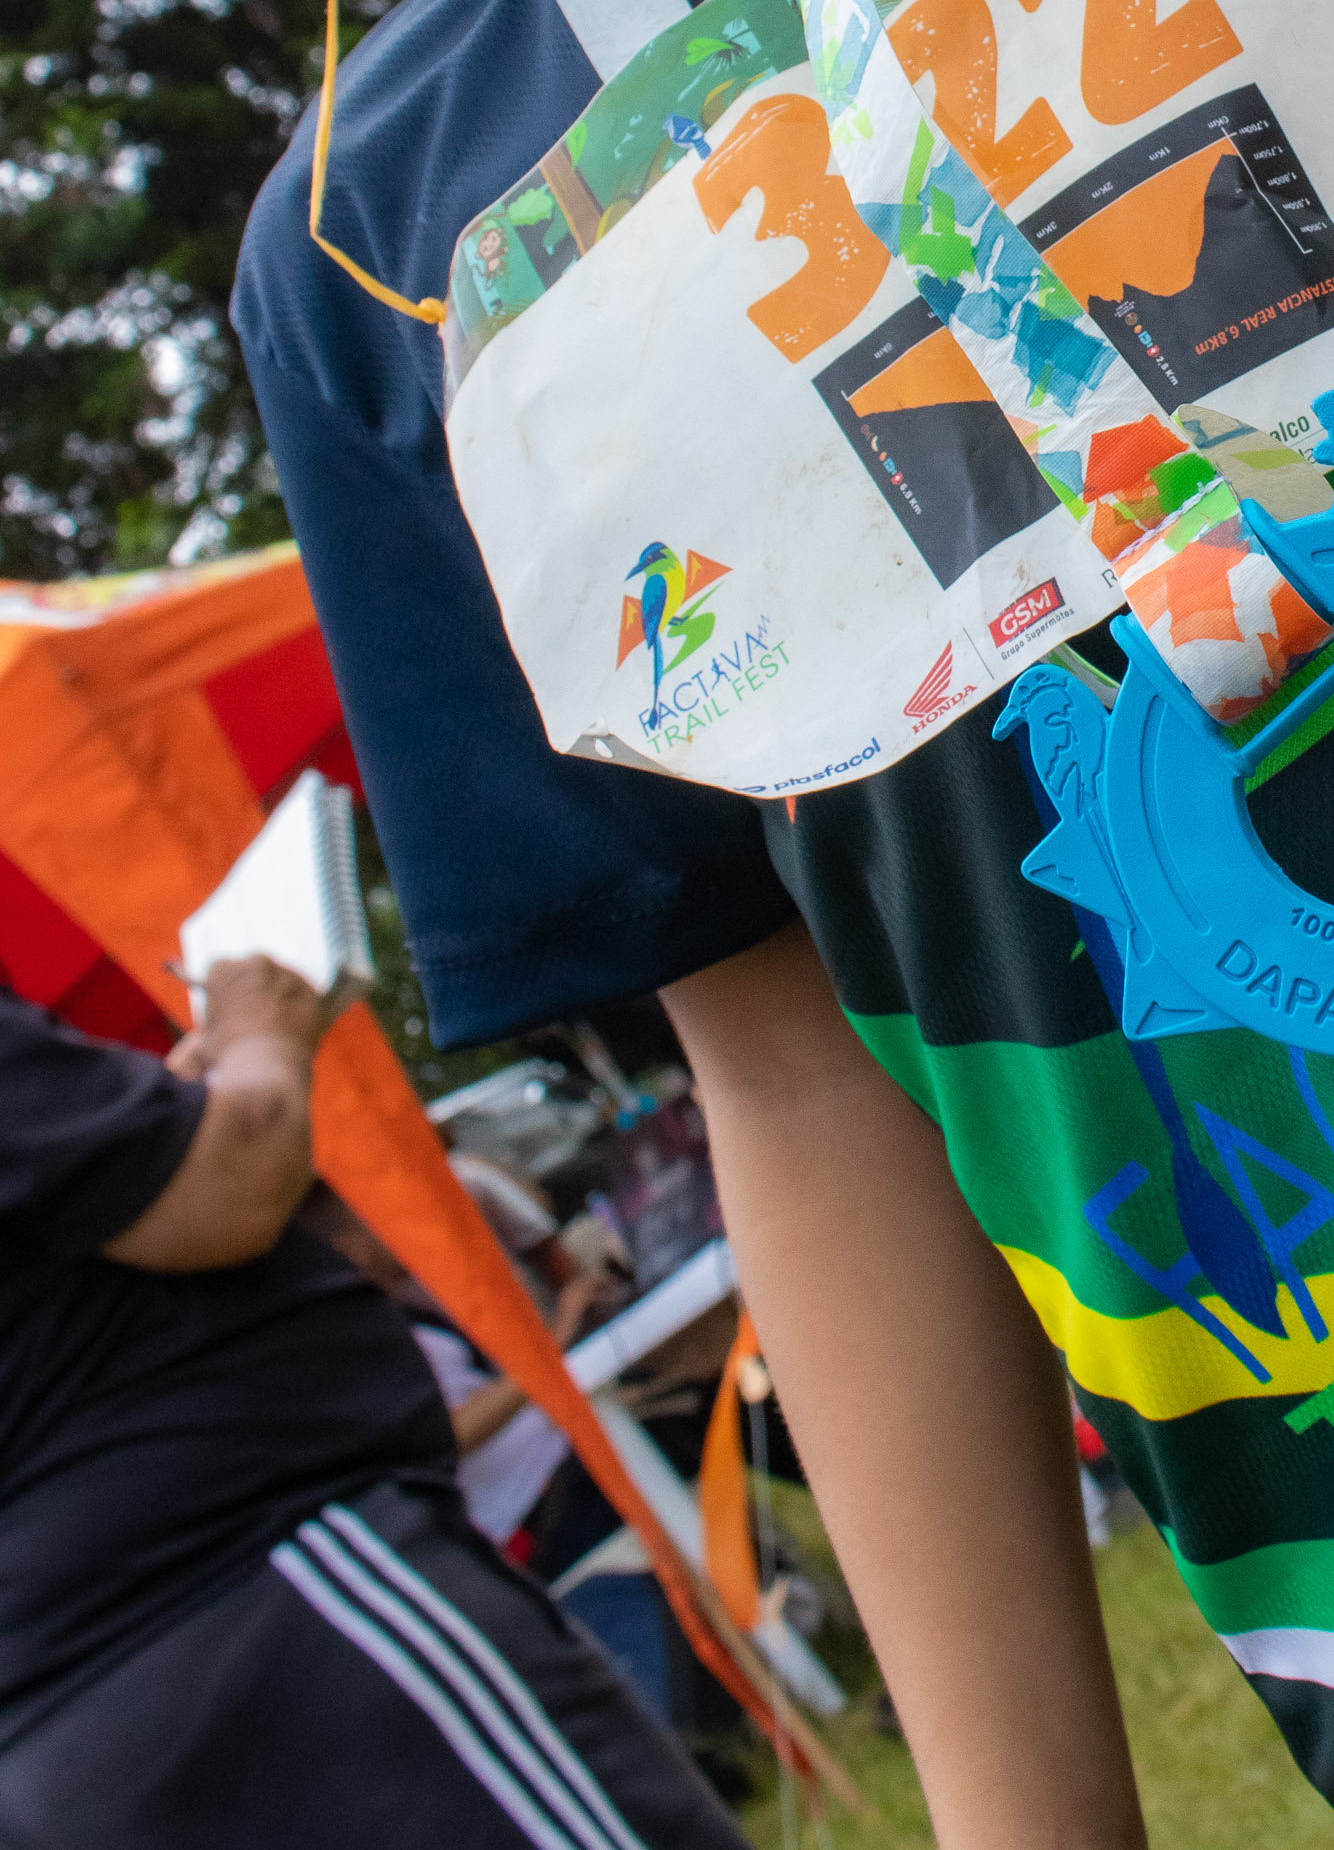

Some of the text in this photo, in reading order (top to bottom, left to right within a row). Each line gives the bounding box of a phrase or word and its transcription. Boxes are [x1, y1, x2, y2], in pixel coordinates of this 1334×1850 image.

[1149, 146, 1171, 161] 1Km
[1091, 181, 1114, 199] 2Km
[1036, 221, 1058, 239] 3Km
[1240, 305, 1277, 331] REAL
[1000, 589, 1052, 636] GSM
[647, 640, 790, 754] TRAIL FEST
[911, 684, 978, 734] HONDA
